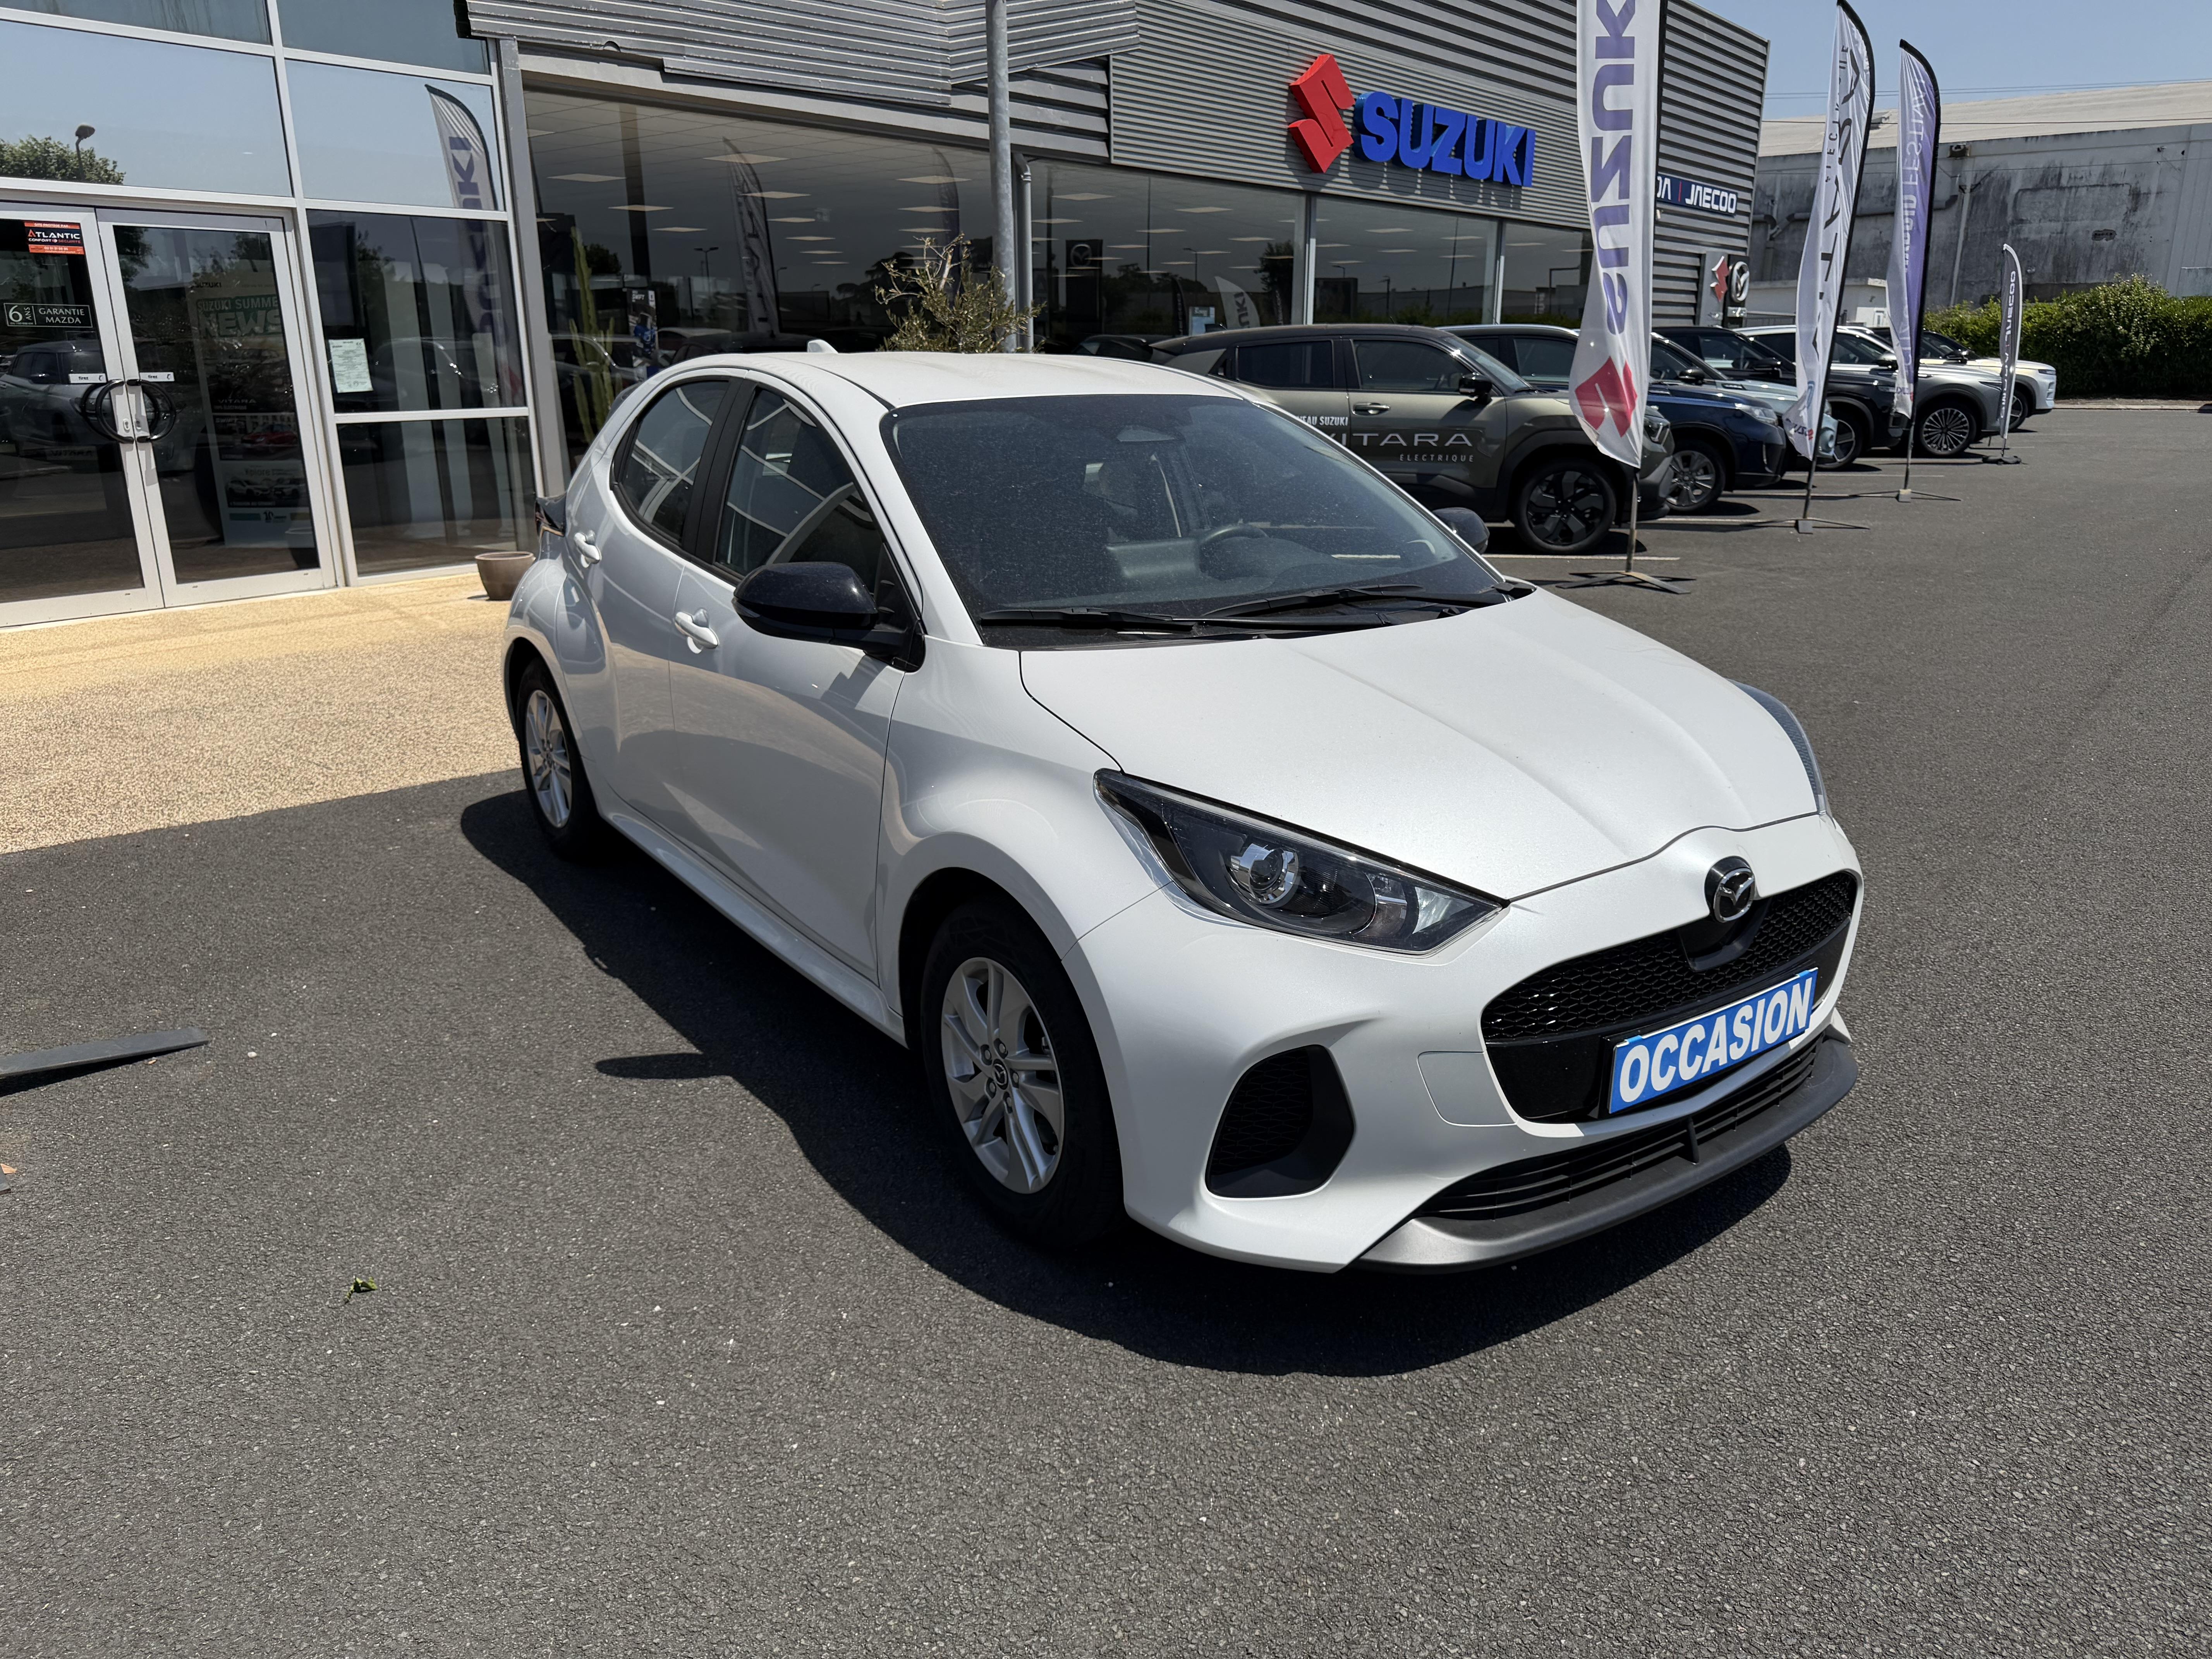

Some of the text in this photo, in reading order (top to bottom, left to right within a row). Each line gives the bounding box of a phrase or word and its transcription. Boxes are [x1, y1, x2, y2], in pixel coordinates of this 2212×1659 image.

[1355, 91, 1536, 187] SUZUKI
[1685, 184, 1737, 213] JAECOO
[28, 229, 81, 239] ATLANTIC
[9, 305, 32, 322] 6 ANS
[1319, 416, 1348, 426] SUZUKI
[1620, 977, 1812, 1102] OCCASION
